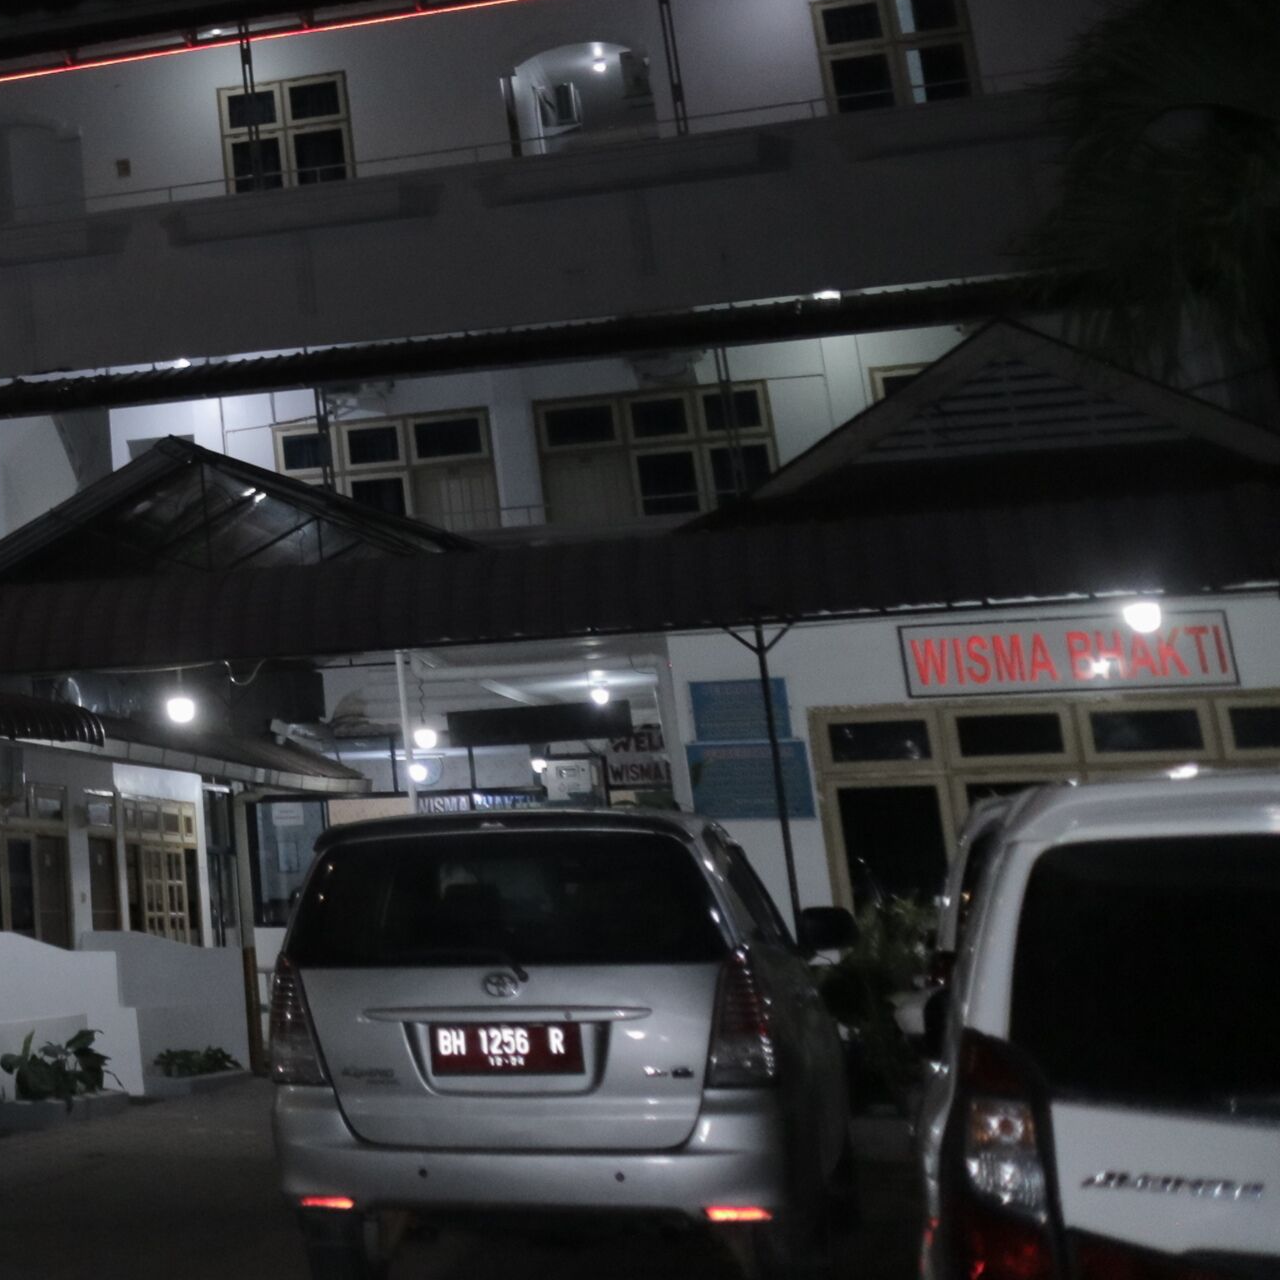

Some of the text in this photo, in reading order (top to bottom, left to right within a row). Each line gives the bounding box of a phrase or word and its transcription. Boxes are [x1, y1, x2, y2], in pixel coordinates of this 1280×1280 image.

[910, 624, 1230, 686] WISMA BHAKTI
[437, 1026, 565, 1056] BH 1256 R
